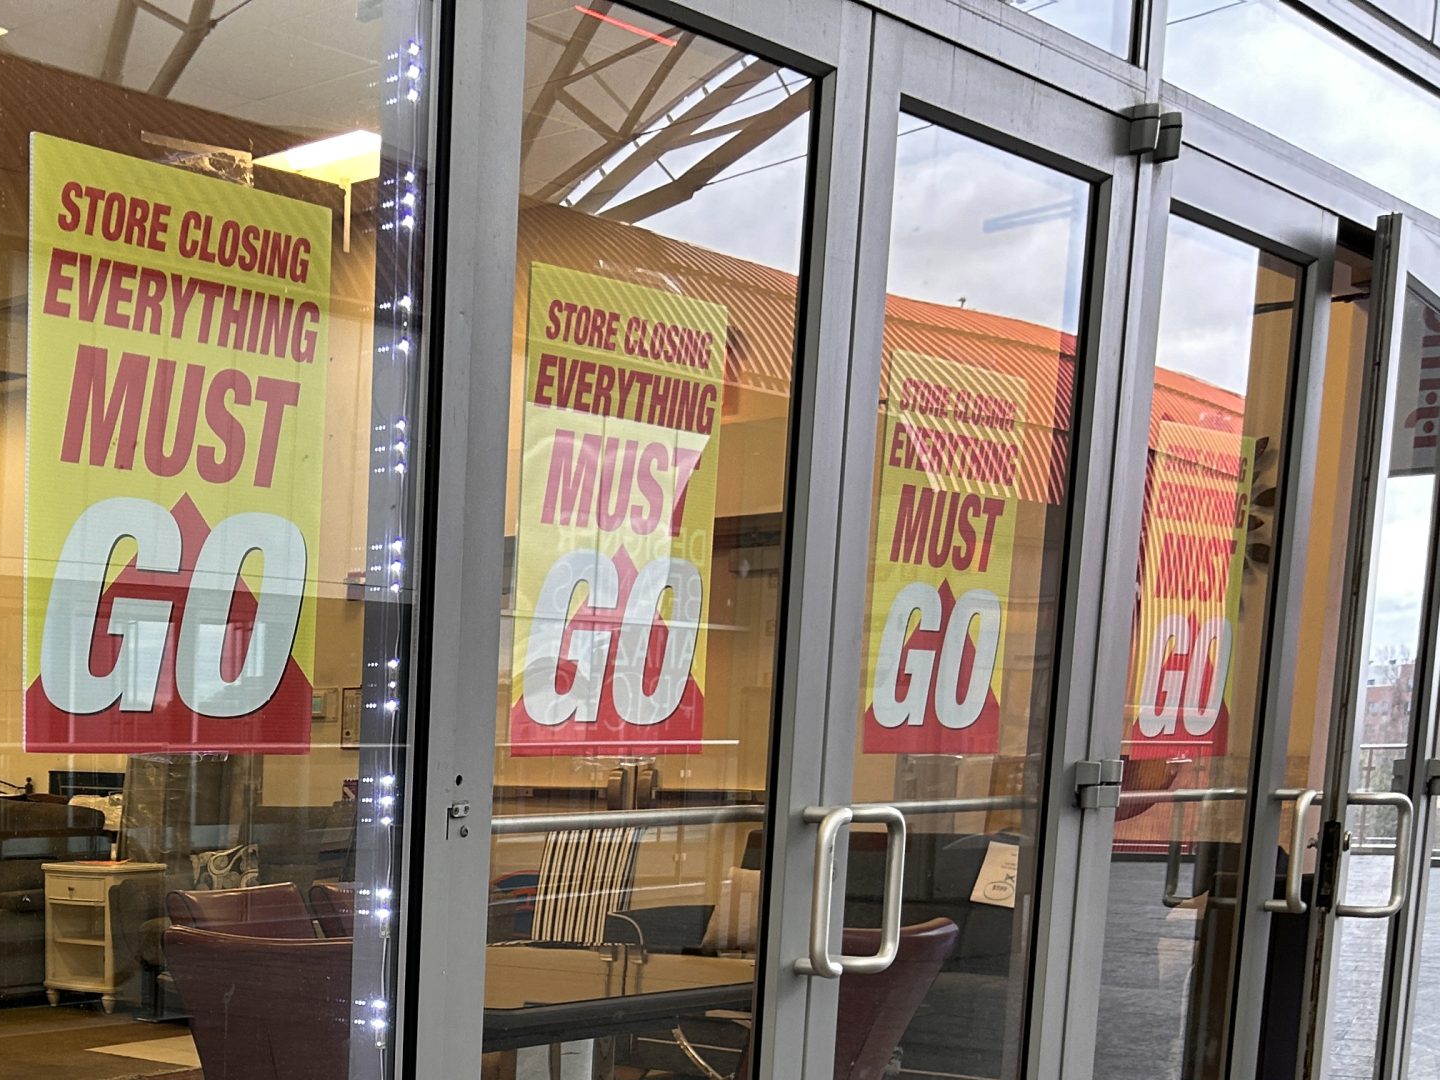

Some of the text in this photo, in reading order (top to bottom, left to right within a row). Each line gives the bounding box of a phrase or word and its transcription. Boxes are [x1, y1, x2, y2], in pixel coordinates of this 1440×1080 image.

[57, 181, 311, 284] STORE CLOSING
[42, 247, 320, 364] EVERYTHING
[546, 299, 713, 370] STORE CLOSING
[60, 343, 301, 489] MUST
[533, 353, 717, 436] EVERYTHING
[899, 377, 1018, 432] STORE CLOSING
[540, 429, 701, 538] MUST
[888, 423, 1019, 488] EVERYTHING
[889, 484, 1005, 573] MUST
[1154, 532, 1238, 602] MUST
[40, 496, 308, 718] GO
[522, 550, 703, 727] GO
[872, 581, 1001, 730] GO
[1138, 614, 1233, 738] GO
